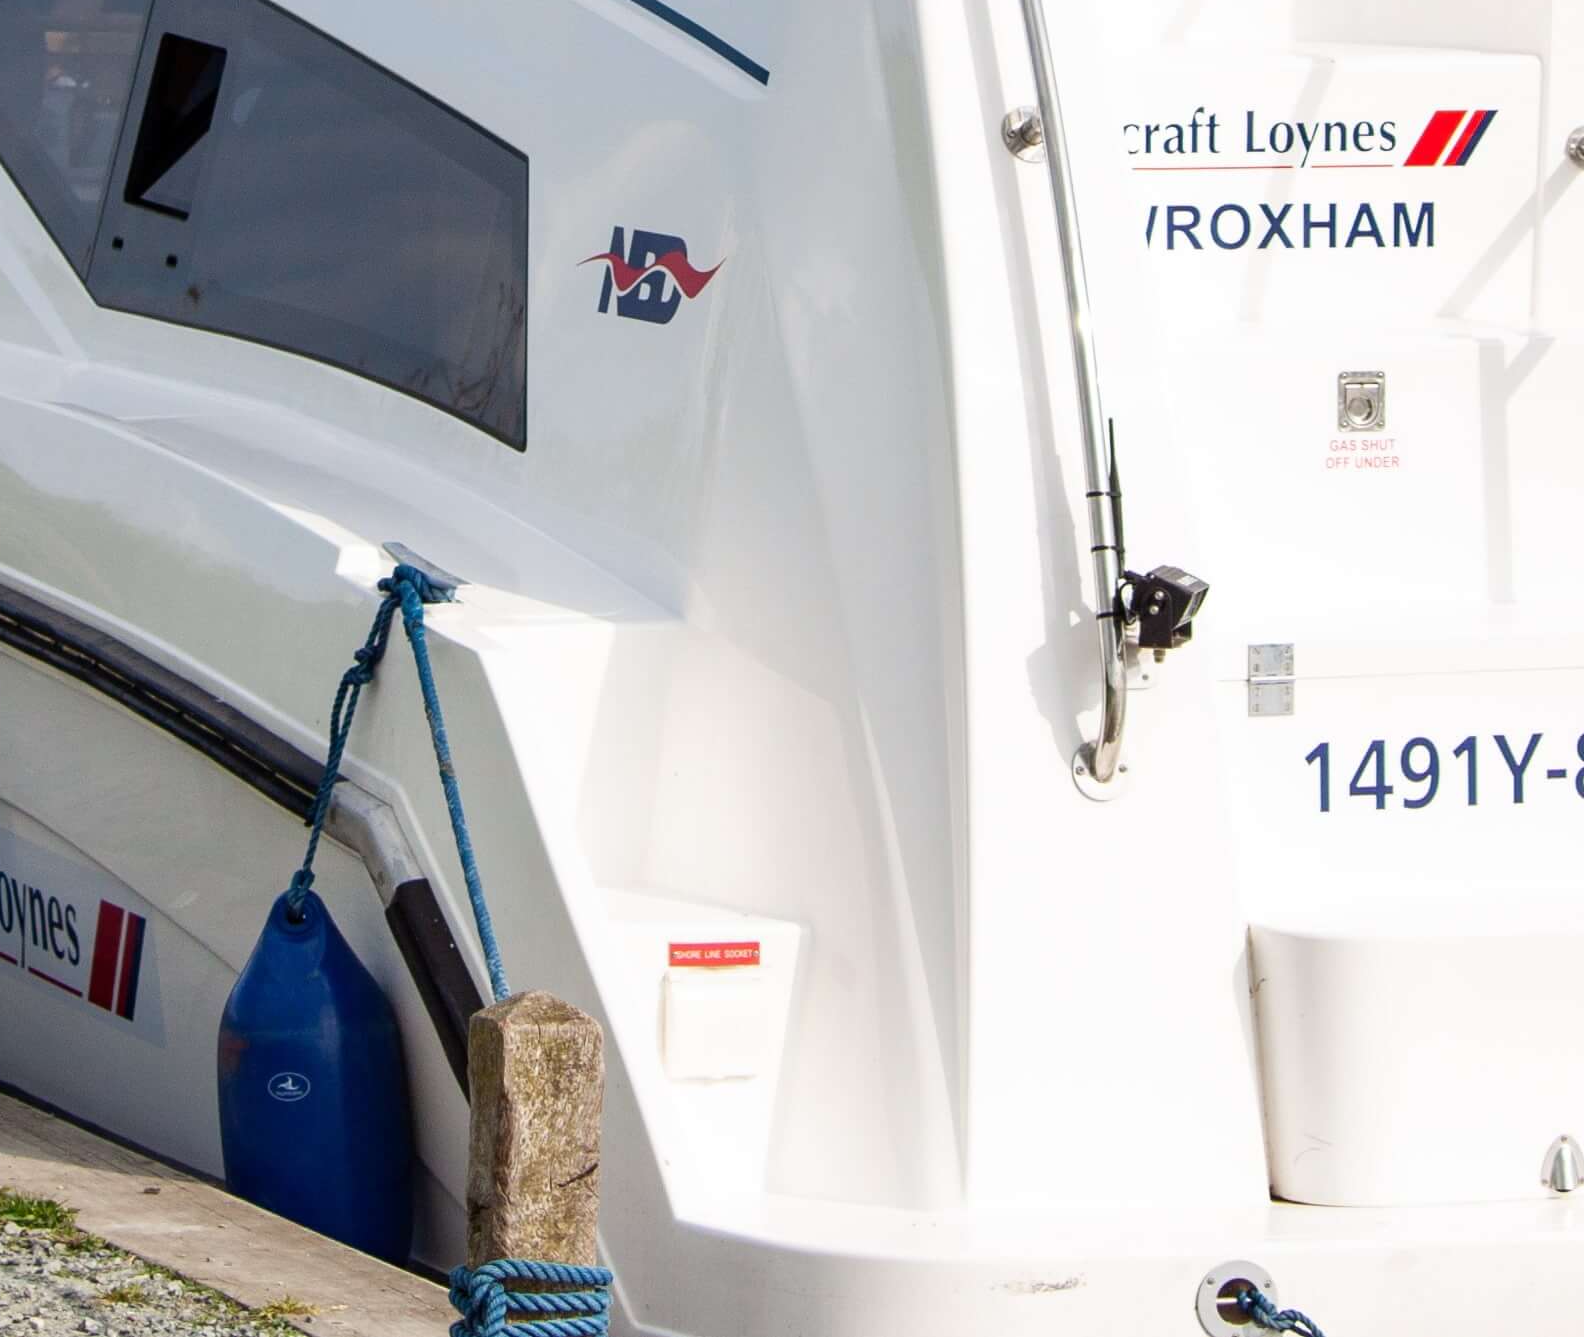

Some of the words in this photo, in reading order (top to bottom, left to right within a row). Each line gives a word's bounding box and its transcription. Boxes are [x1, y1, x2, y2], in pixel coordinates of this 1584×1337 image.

[1245, 109, 1397, 168] Loynes
[1328, 439, 1357, 452] GAS
[1361, 438, 1396, 451] SHUT
[1325, 457, 1350, 469] OFF
[1354, 455, 1400, 469] UNDER
[723, 949, 754, 959] SOCKET
